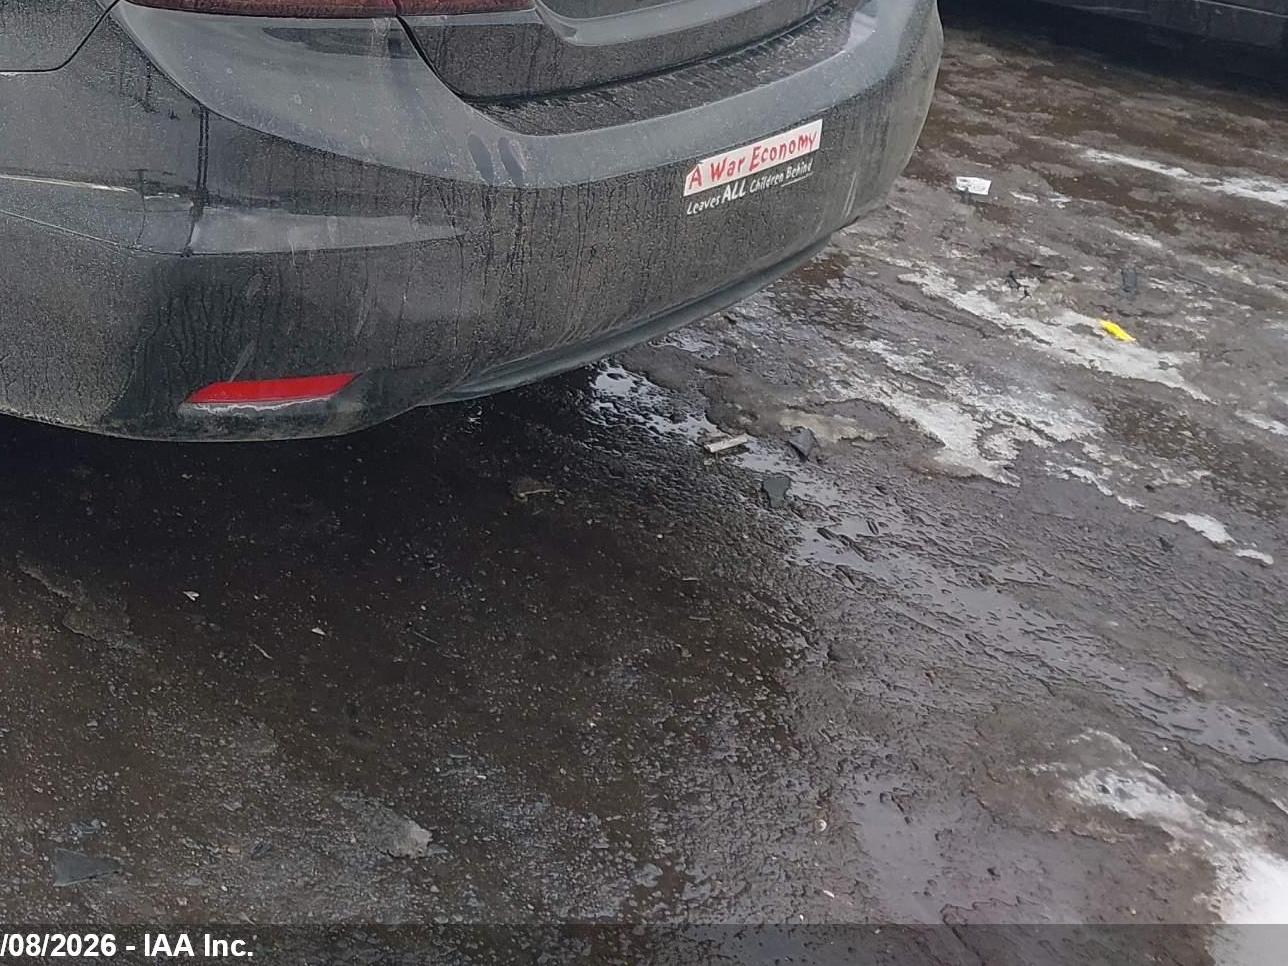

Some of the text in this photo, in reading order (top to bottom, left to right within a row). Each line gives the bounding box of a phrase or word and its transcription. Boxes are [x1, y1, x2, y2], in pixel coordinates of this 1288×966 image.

[686, 157, 814, 214] Leaves ALL Children Behind
[688, 129, 818, 190] A War Economy
